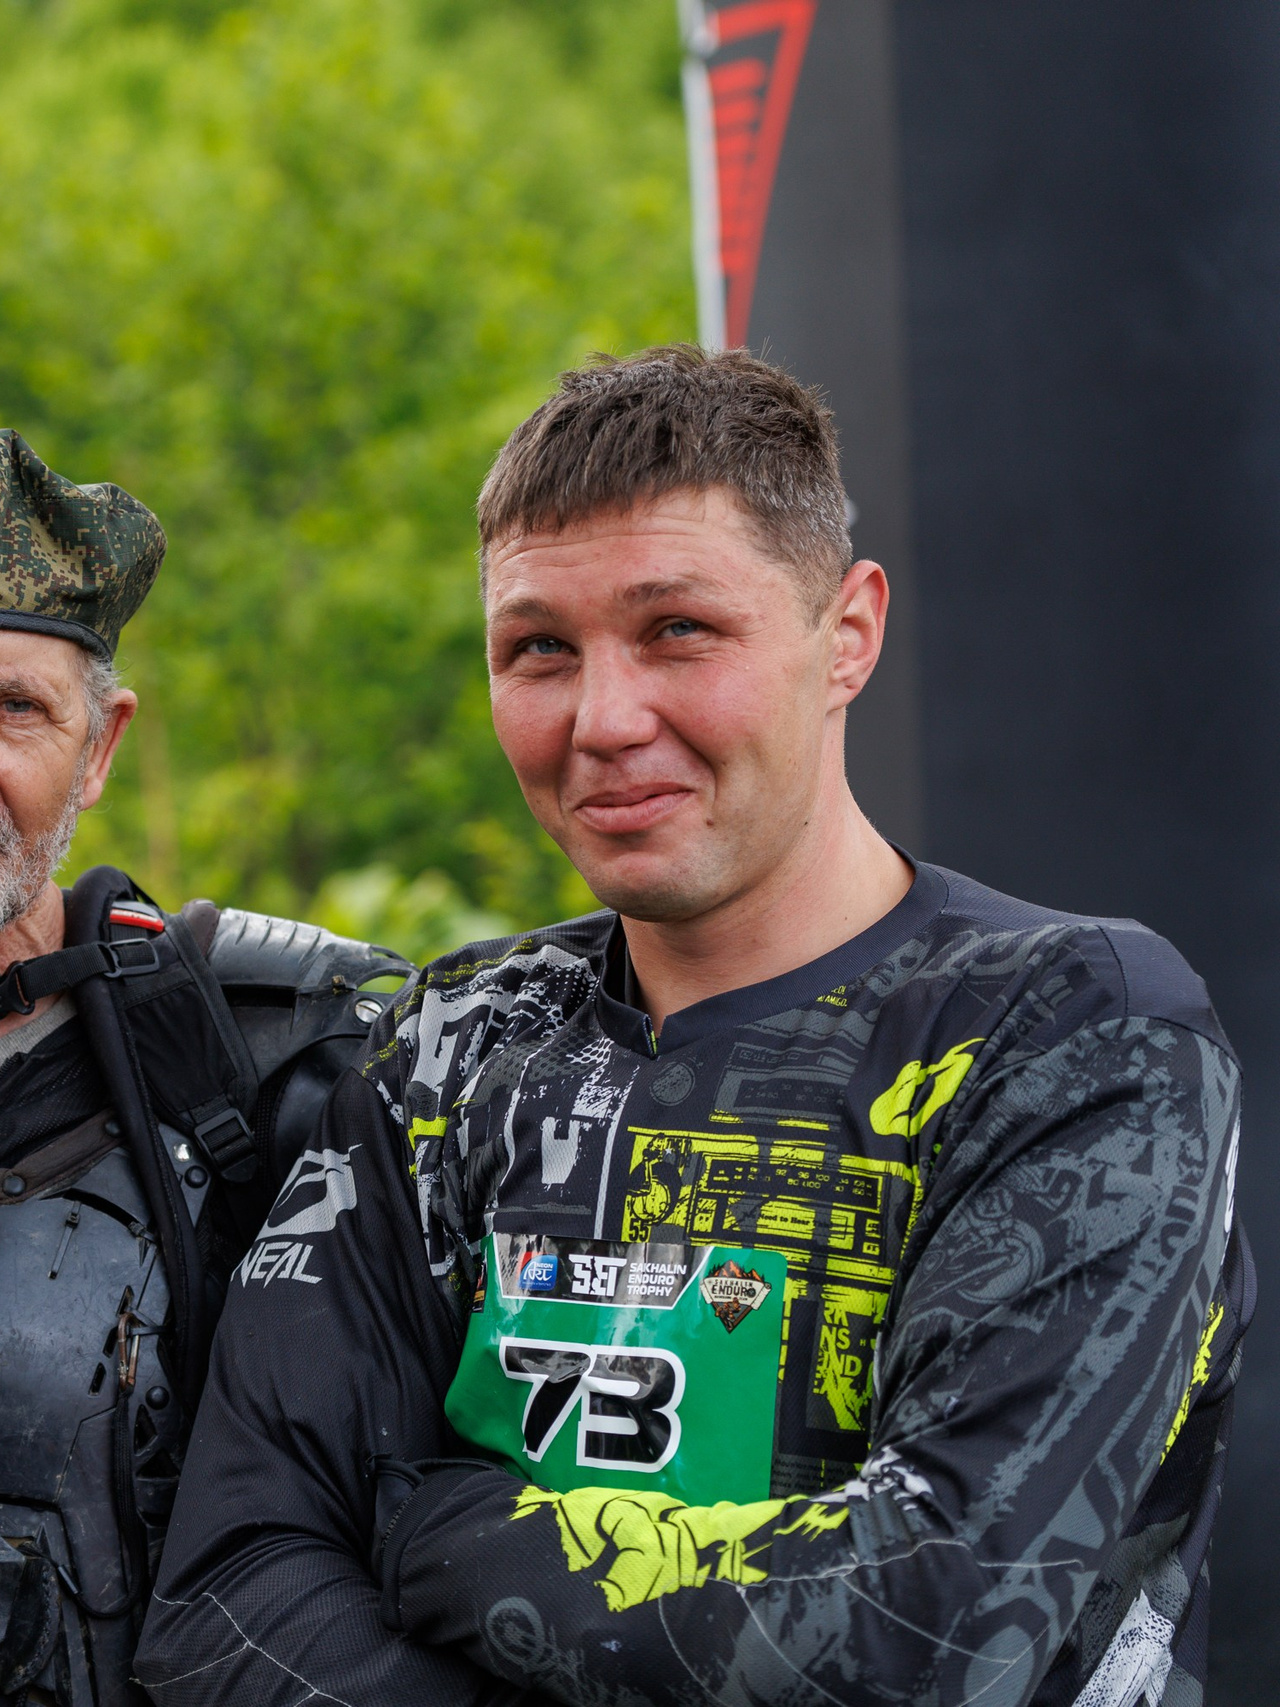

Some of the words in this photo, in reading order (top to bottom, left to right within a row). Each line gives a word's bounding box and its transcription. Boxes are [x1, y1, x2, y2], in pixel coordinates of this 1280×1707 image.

[628, 1218, 650, 1242] 55
[629, 1262, 687, 1275] SAKHALIN
[628, 1274, 675, 1286] ENDURO
[627, 1285, 673, 1297] TROPHY
[499, 1336, 687, 1473] 73
